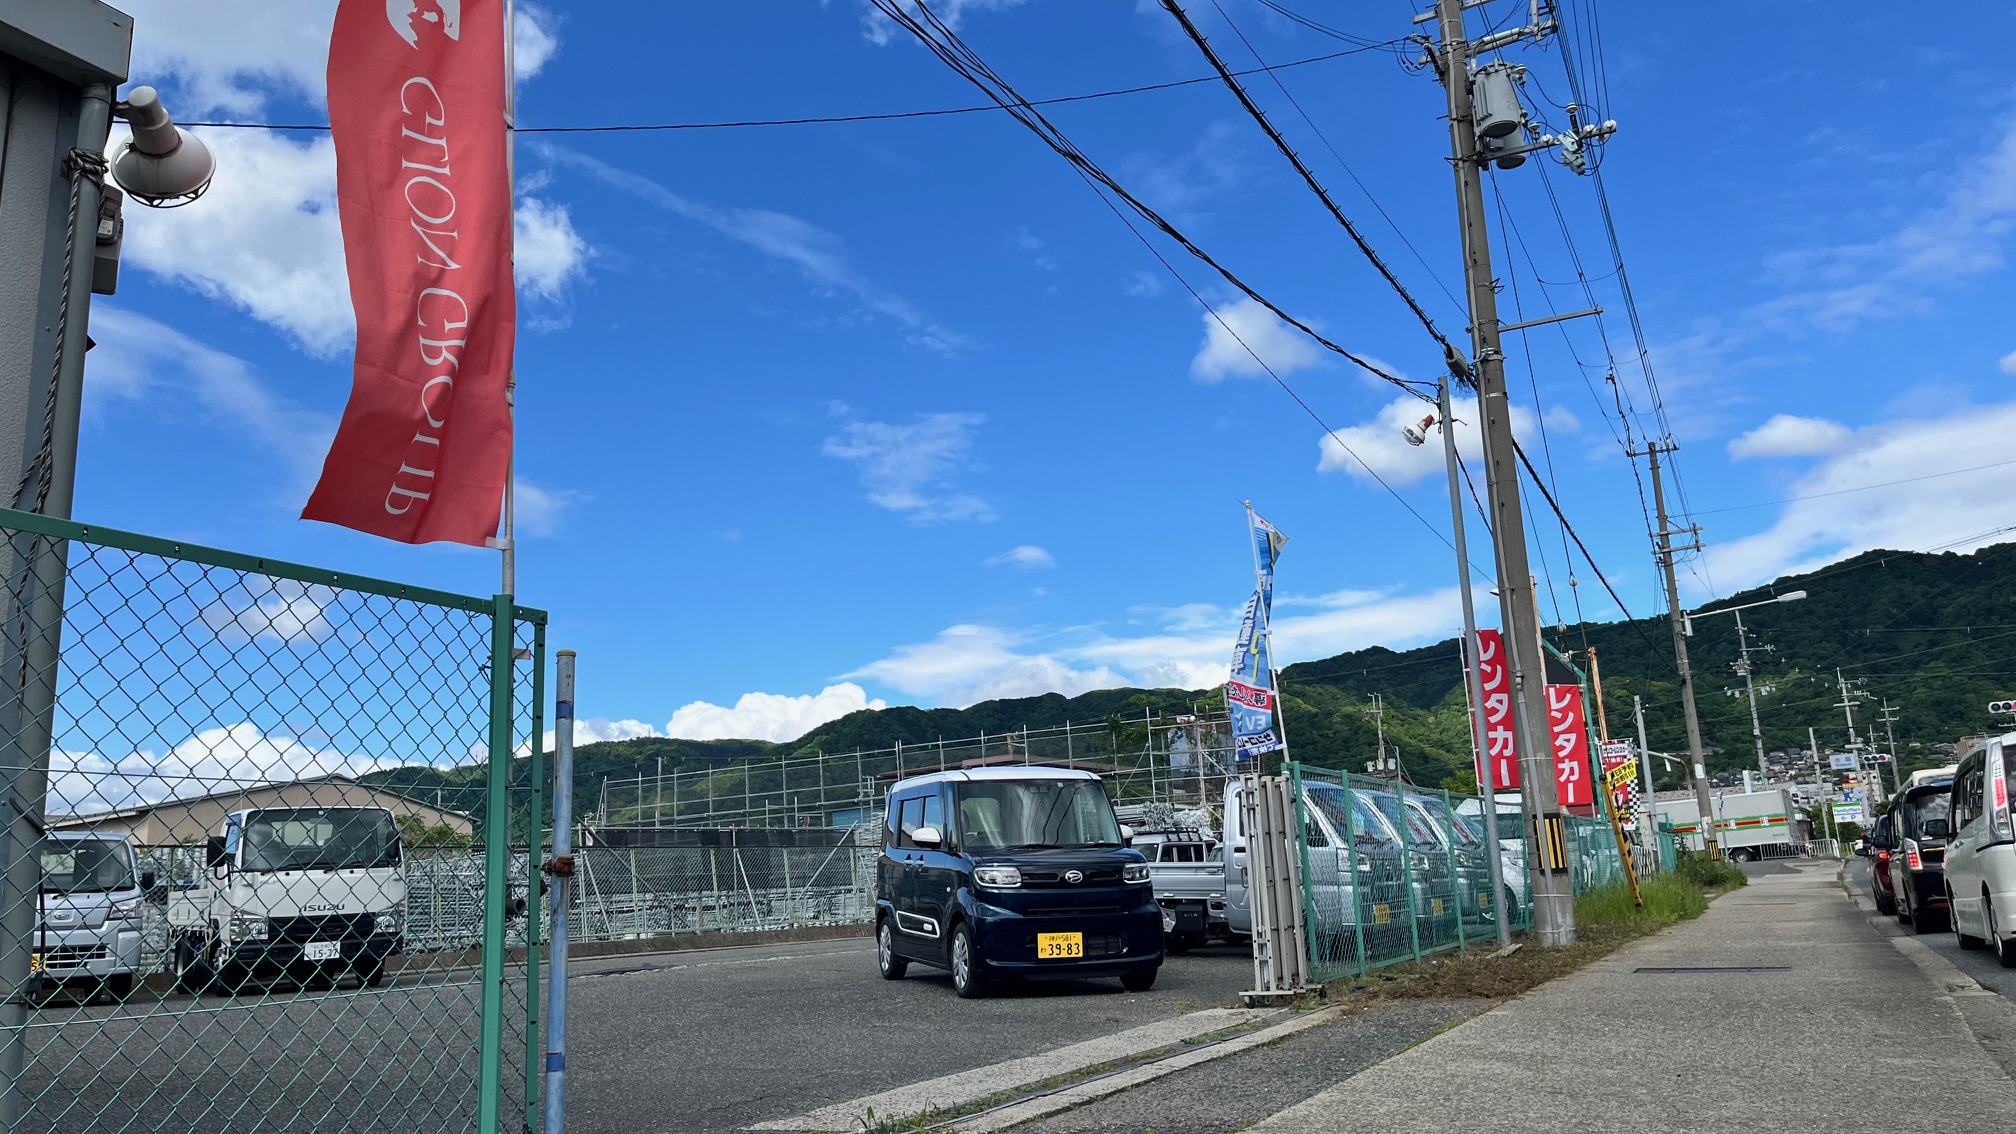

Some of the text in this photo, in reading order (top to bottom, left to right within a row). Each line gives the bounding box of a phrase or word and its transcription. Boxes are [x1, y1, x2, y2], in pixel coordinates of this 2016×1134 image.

[1475, 632, 1514, 787] レンタカー
[1548, 687, 1580, 803] レンタカー
[303, 903, 345, 912] ISUZU
[1048, 943, 1080, 956] 39-83
